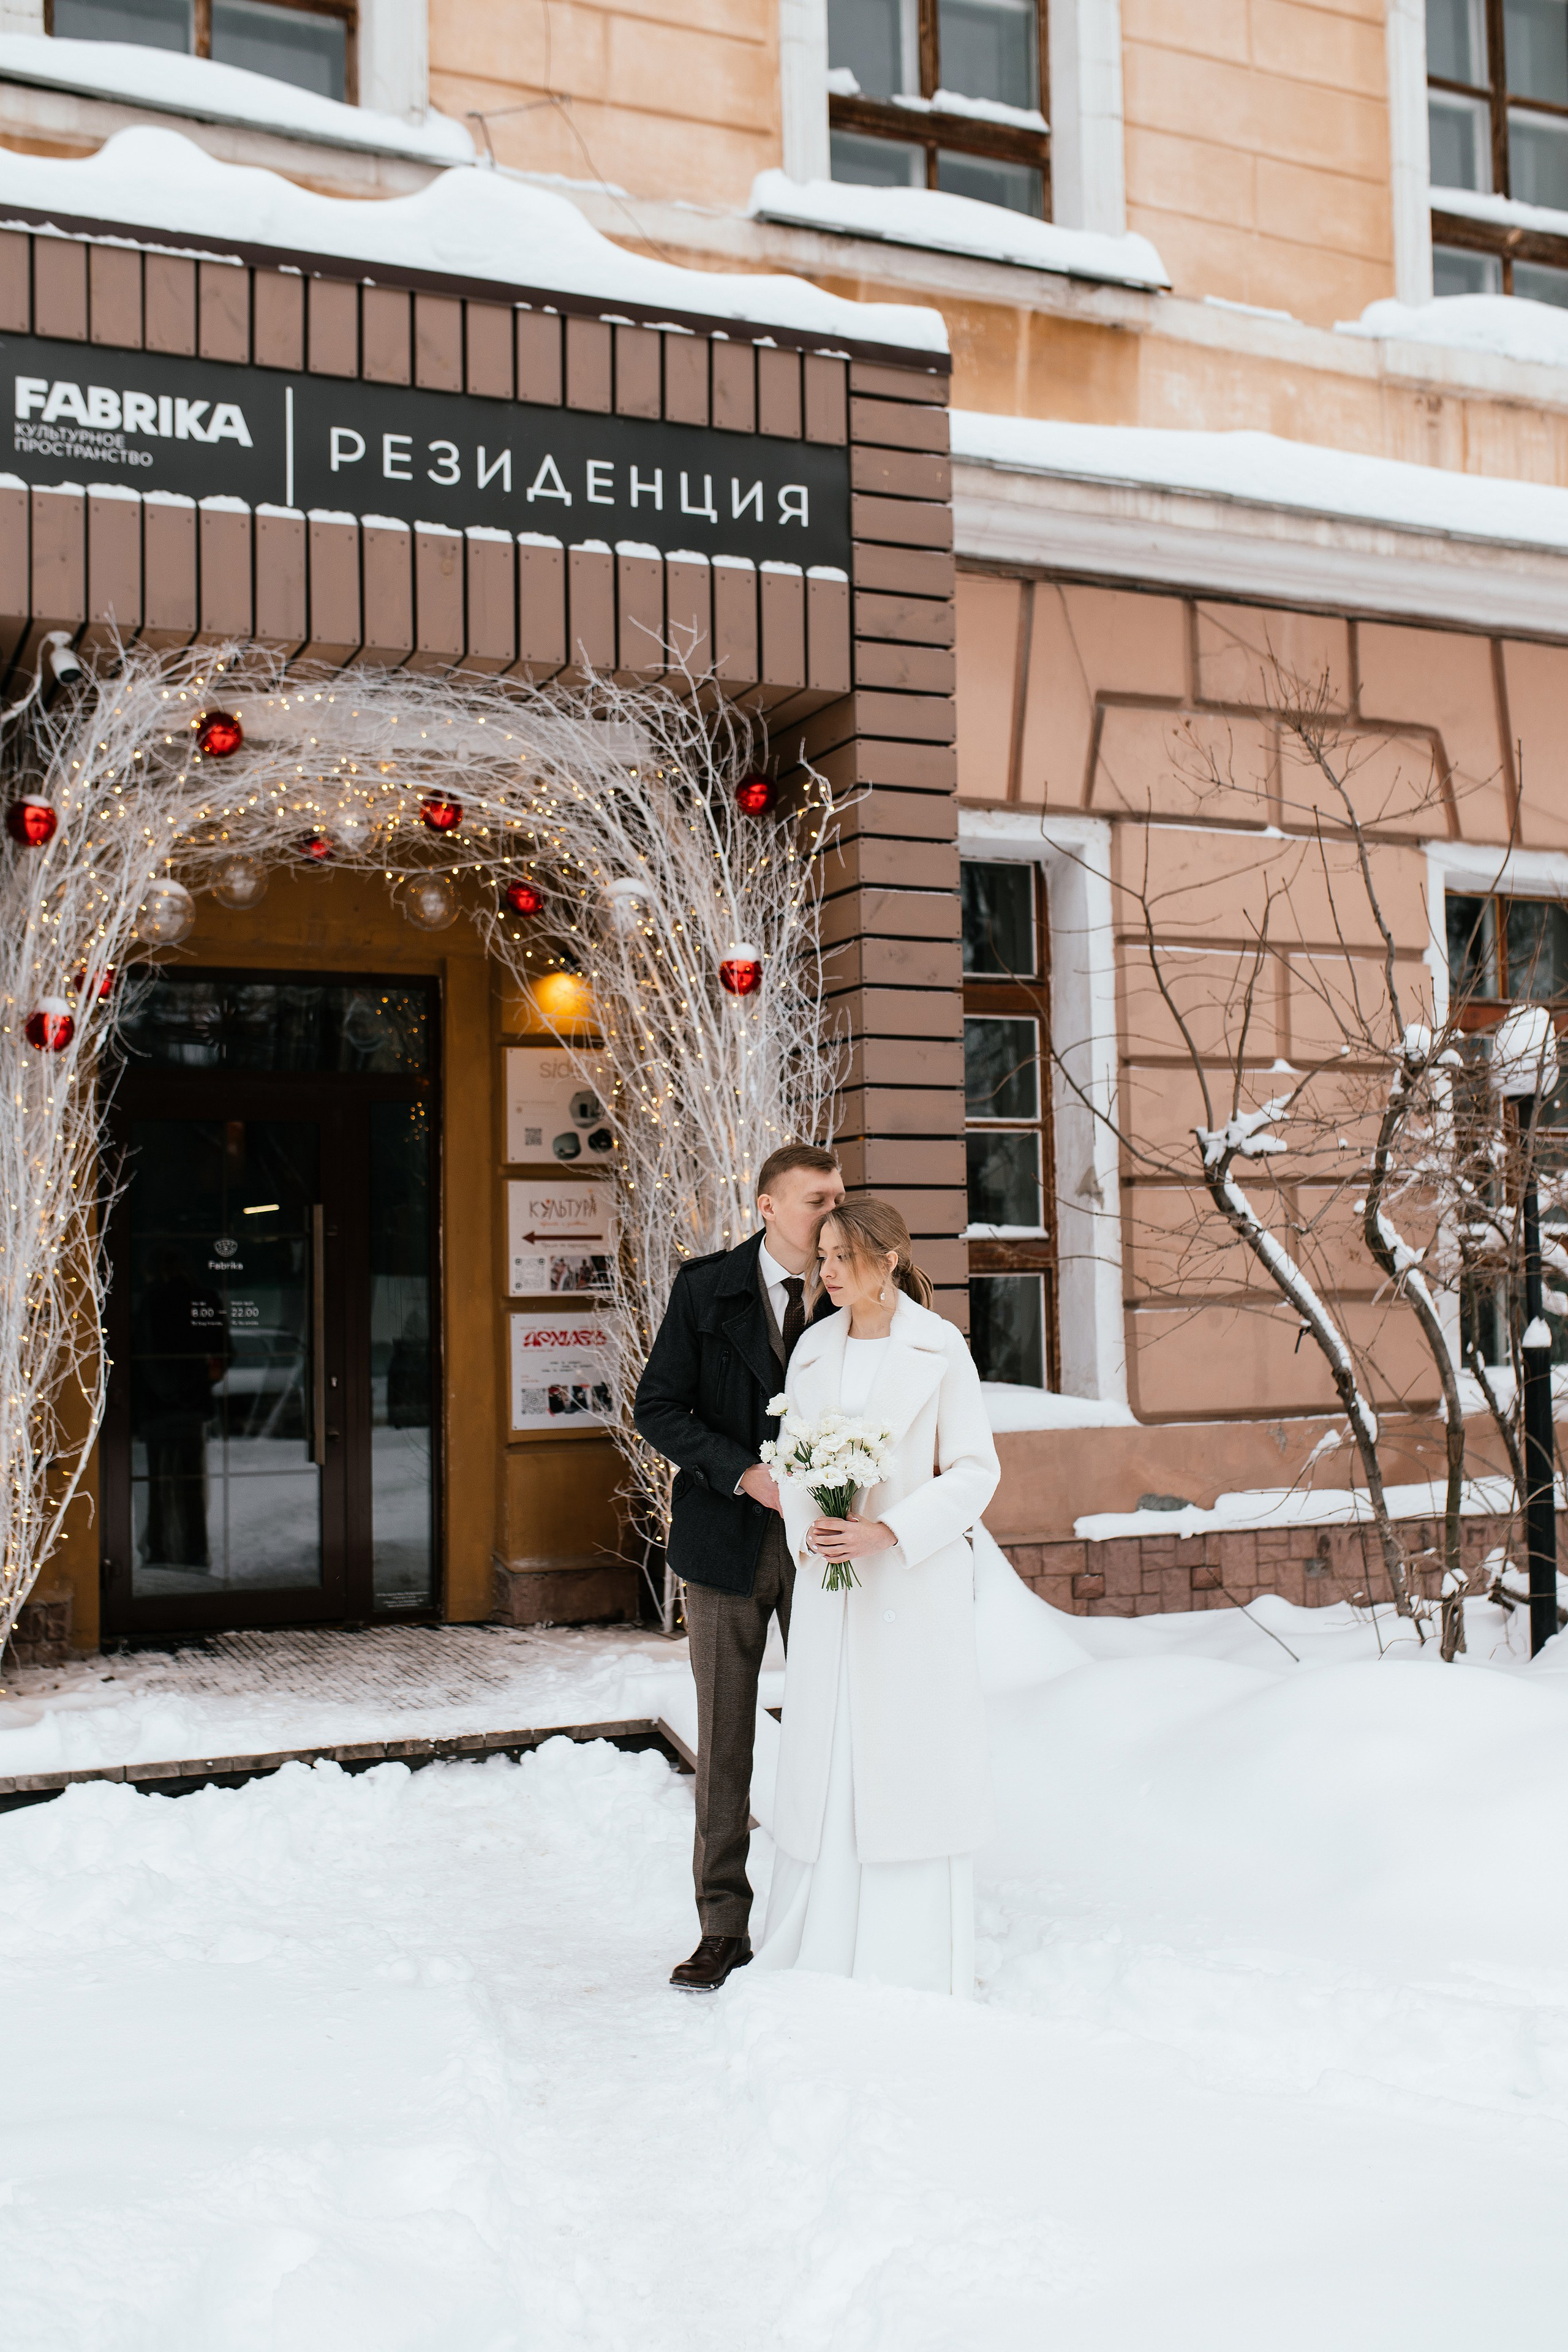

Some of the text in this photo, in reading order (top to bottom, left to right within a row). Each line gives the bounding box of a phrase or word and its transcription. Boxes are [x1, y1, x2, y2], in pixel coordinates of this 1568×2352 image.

[15, 375, 254, 448] FABRIKA
[14, 421, 126, 450] КУЛЬТУРНОЕ
[14, 437, 154, 467] ПРОСТРАНСТВО
[330, 426, 810, 528] РЕЗИДЕНЦИЯ
[208, 1260, 244, 1270] Fabrika
